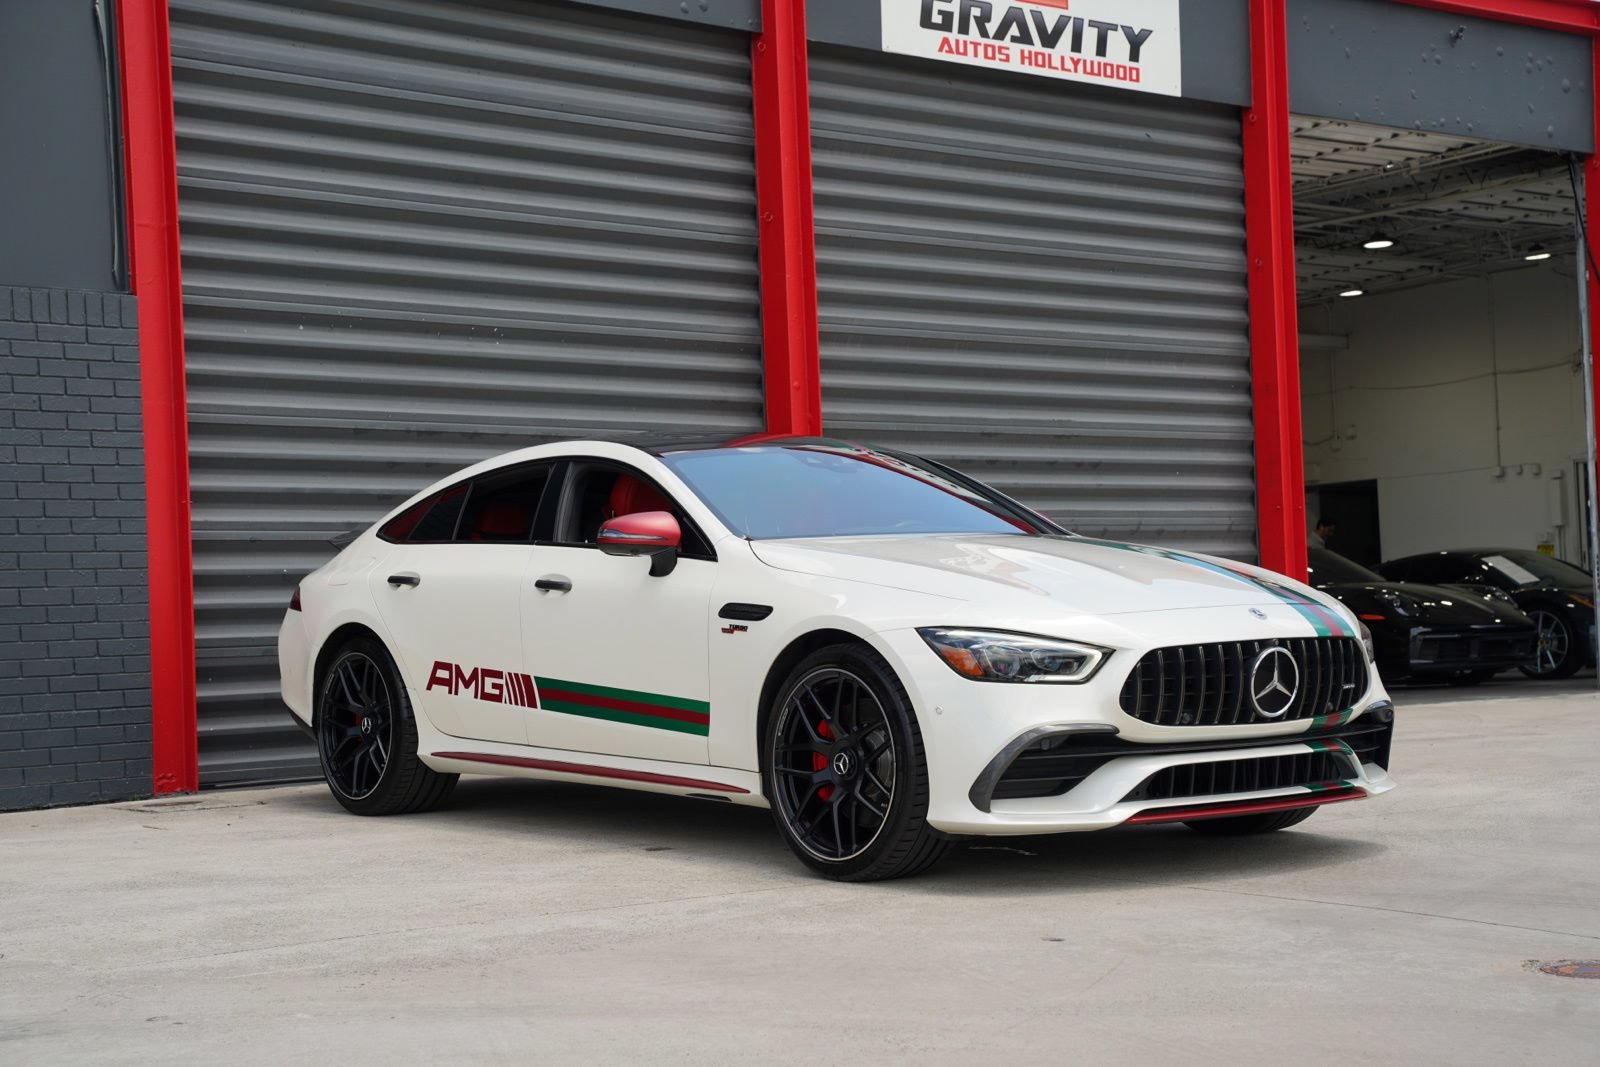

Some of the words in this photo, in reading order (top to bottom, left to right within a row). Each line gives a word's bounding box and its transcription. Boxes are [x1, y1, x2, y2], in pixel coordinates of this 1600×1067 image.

[919, 0, 1153, 63] GRAVITY
[937, 36, 1011, 63] AUTOS
[1020, 48, 1141, 83] HOLLYWOOD
[426, 660, 504, 704] AMG
